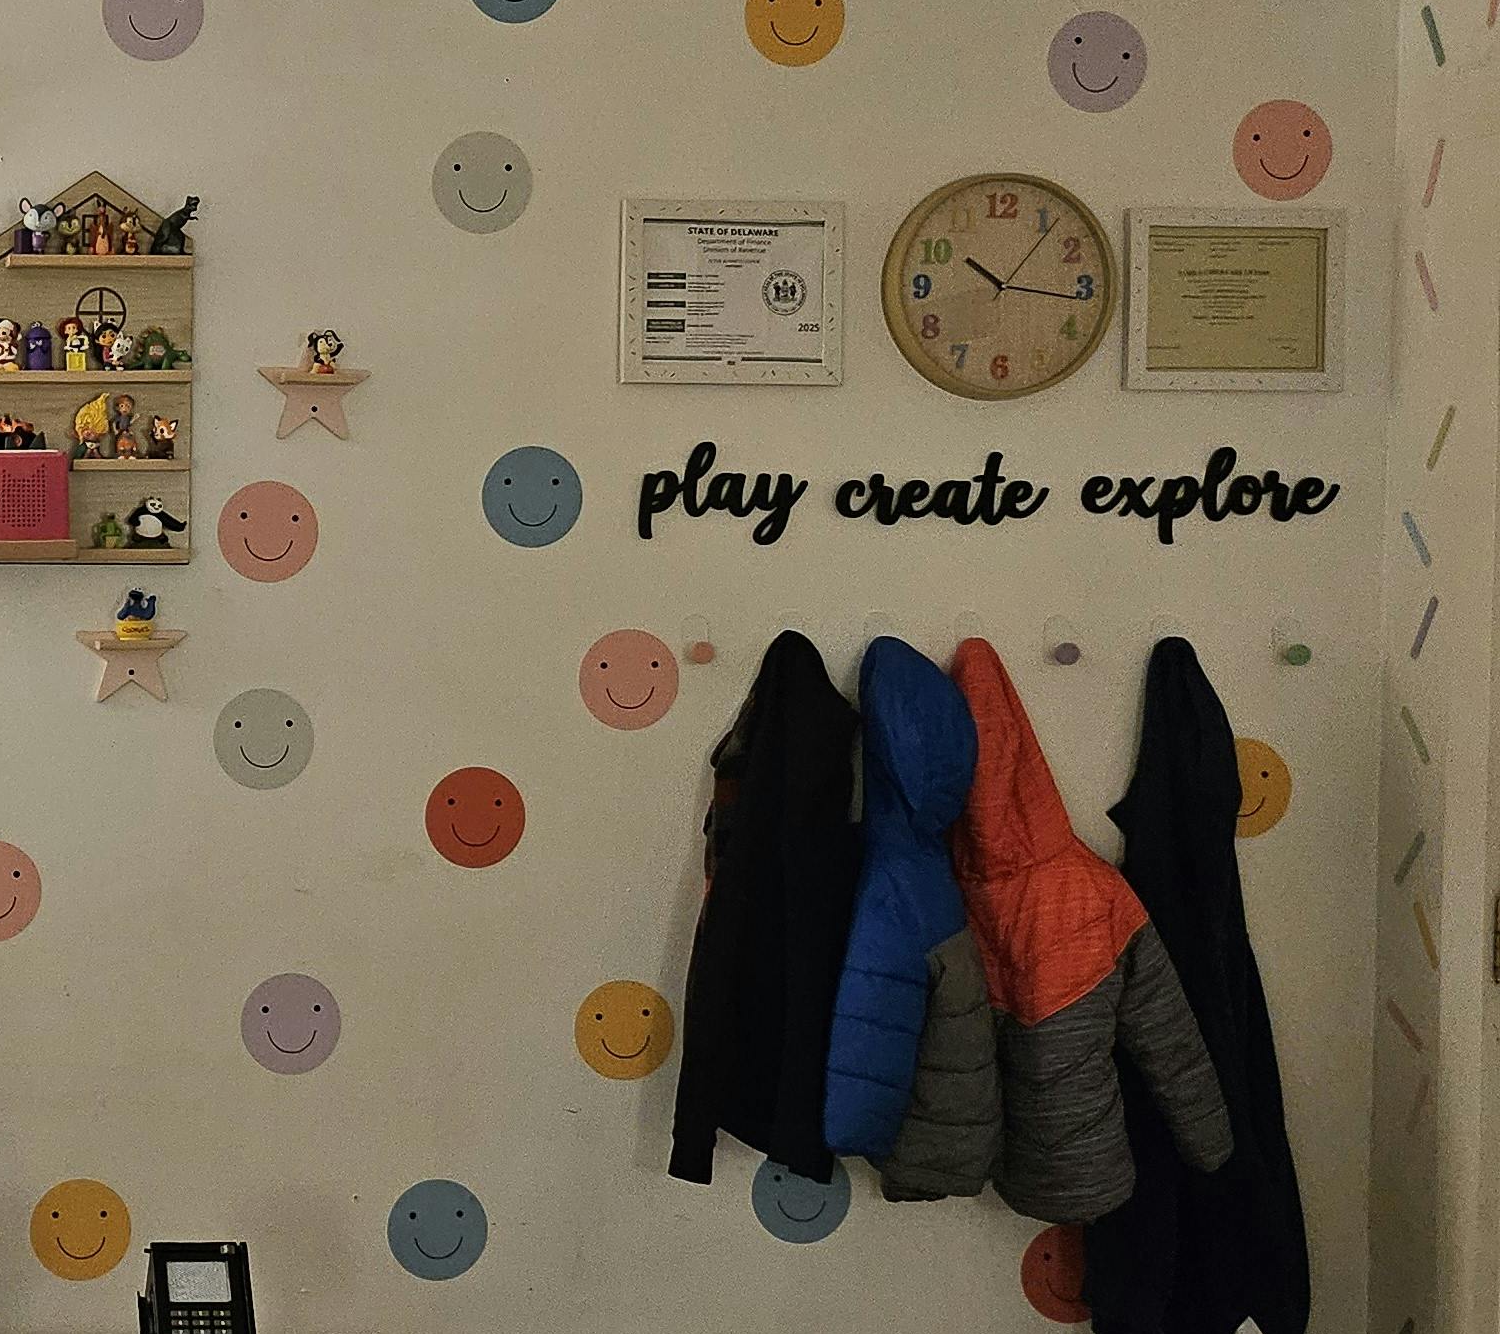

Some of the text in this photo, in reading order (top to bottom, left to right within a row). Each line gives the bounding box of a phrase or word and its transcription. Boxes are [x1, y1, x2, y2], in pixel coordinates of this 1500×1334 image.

[985, 193, 1018, 218] 12
[687, 227, 714, 235] STATE
[730, 228, 779, 236] DELAWARE
[1036, 207, 1050, 234] 1
[920, 238, 952, 265] 10
[1062, 237, 1081, 264] 2
[912, 274, 932, 299] 9
[1076, 274, 1094, 301] 3
[797, 323, 820, 332] 2025
[921, 314, 941, 339] 8
[1059, 315, 1079, 340] 4
[950, 344, 969, 369] 7
[990, 355, 1009, 379] 6
[637, 441, 1341, 545] play create explore
